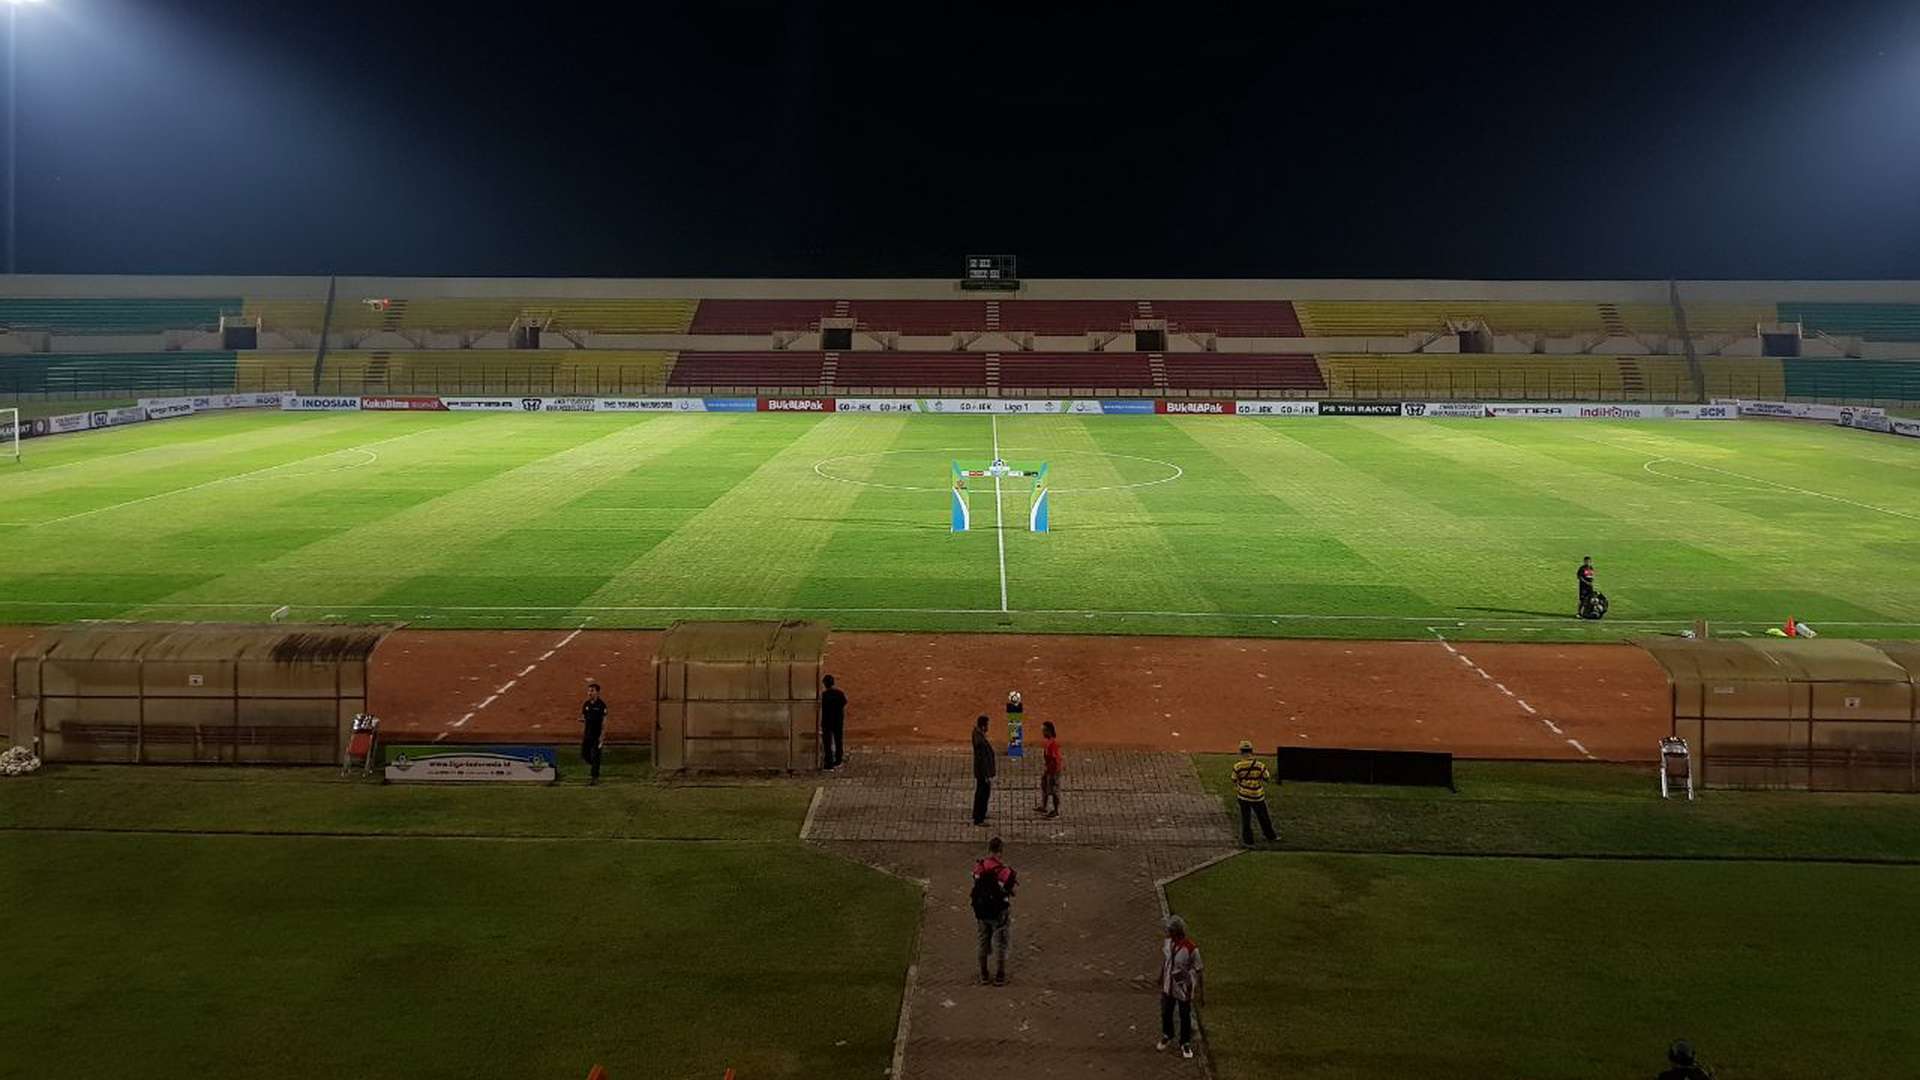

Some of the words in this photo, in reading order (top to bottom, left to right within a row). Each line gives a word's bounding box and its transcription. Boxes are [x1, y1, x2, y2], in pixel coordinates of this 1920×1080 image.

[302, 399, 357, 409] INDOSIAR
[1004, 403, 1023, 413] Liga
[1579, 406, 1641, 417] IndiHome
[1699, 406, 1726, 417] SCM
